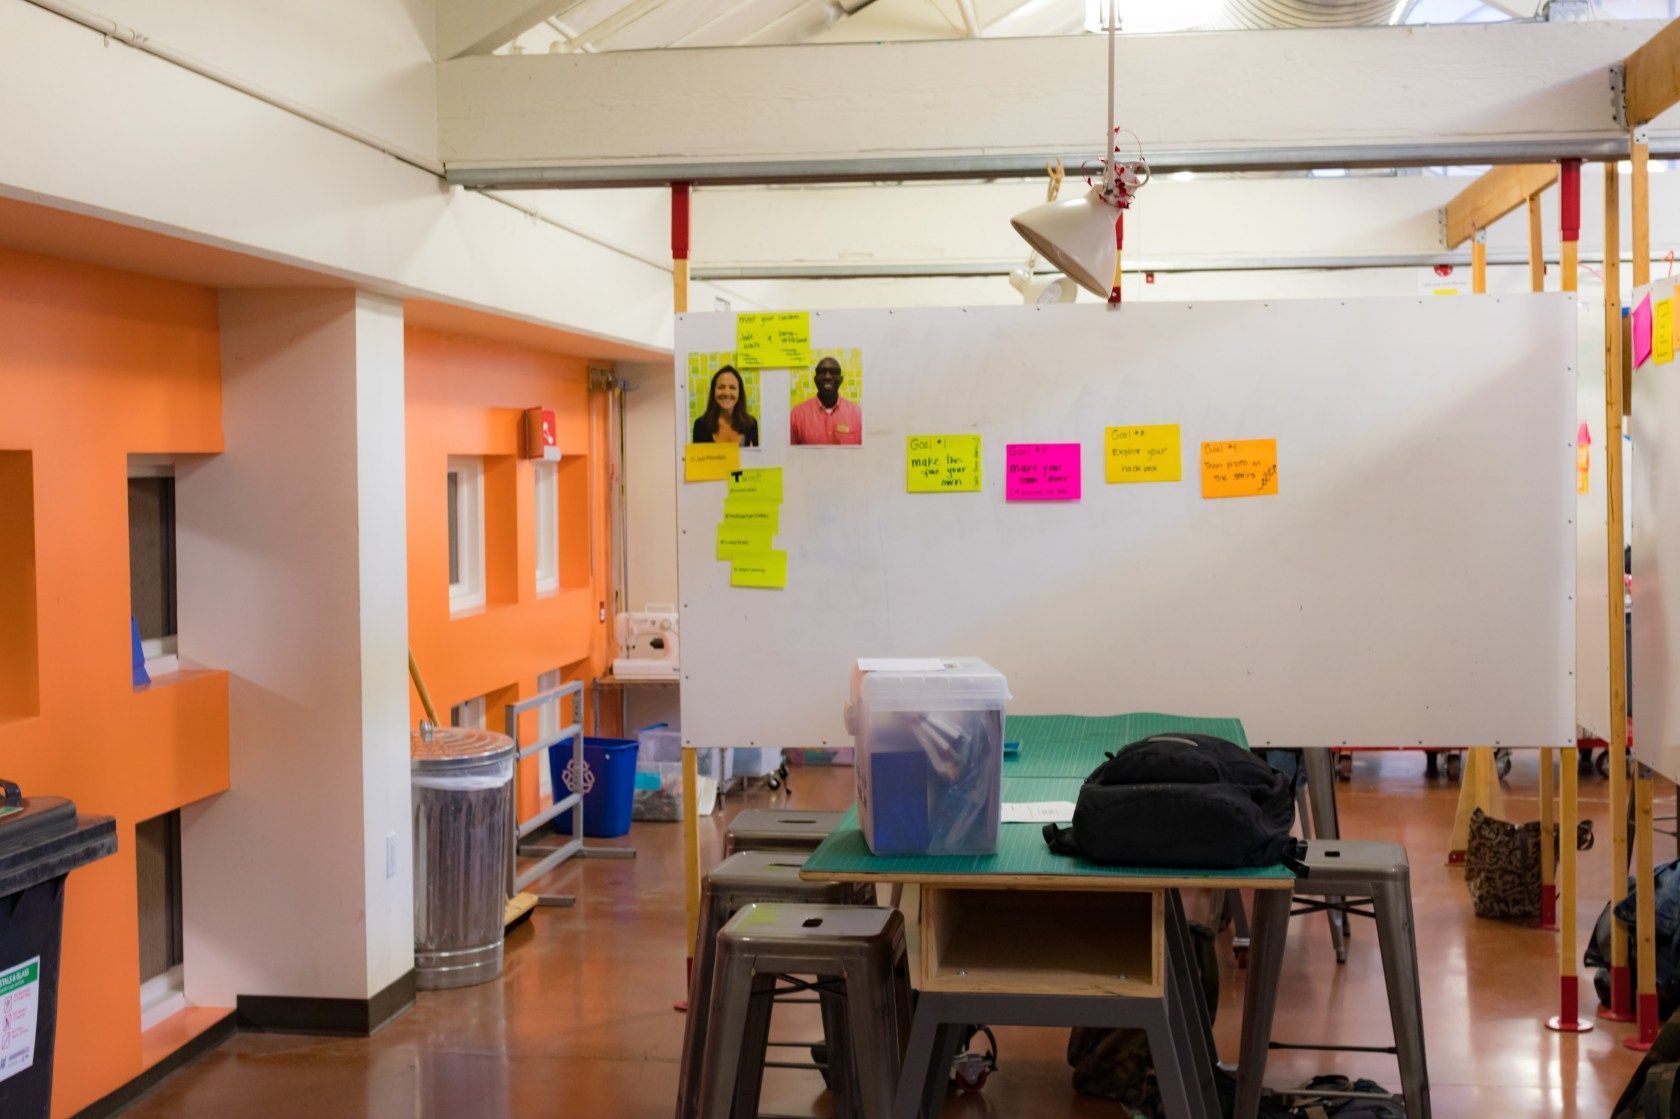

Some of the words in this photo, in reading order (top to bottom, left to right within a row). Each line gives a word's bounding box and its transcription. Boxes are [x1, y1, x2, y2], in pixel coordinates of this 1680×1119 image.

[1111, 429, 1132, 441] Goal
[910, 438, 932, 450] Goal
[1204, 443, 1223, 455] Goal
[1146, 446, 1168, 462] your
[911, 456, 940, 468] make
[946, 466, 966, 478] your
